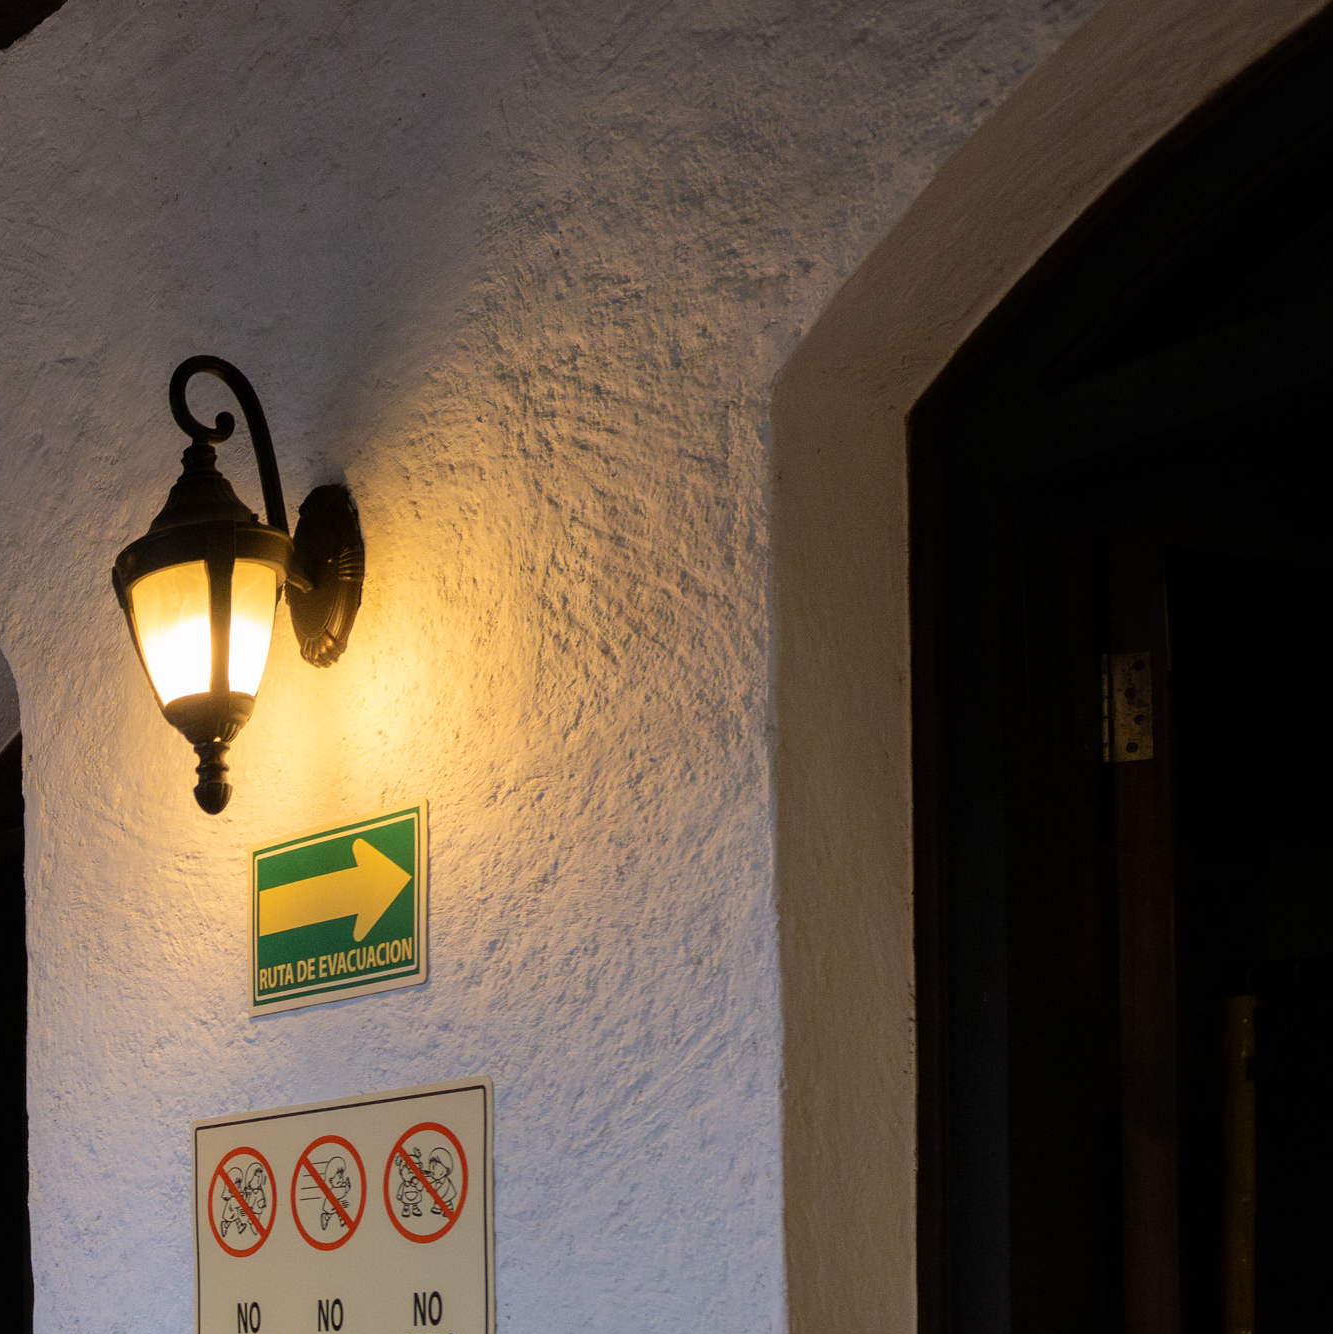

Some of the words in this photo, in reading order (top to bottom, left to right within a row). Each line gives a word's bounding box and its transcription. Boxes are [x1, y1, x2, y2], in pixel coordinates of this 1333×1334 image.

[259, 963, 295, 990] RUTA
[297, 957, 316, 982] DE
[319, 937, 413, 978] EVACUACION
[237, 1301, 261, 1333] NO
[318, 1298, 343, 1332] NO
[413, 1291, 442, 1326] NO
